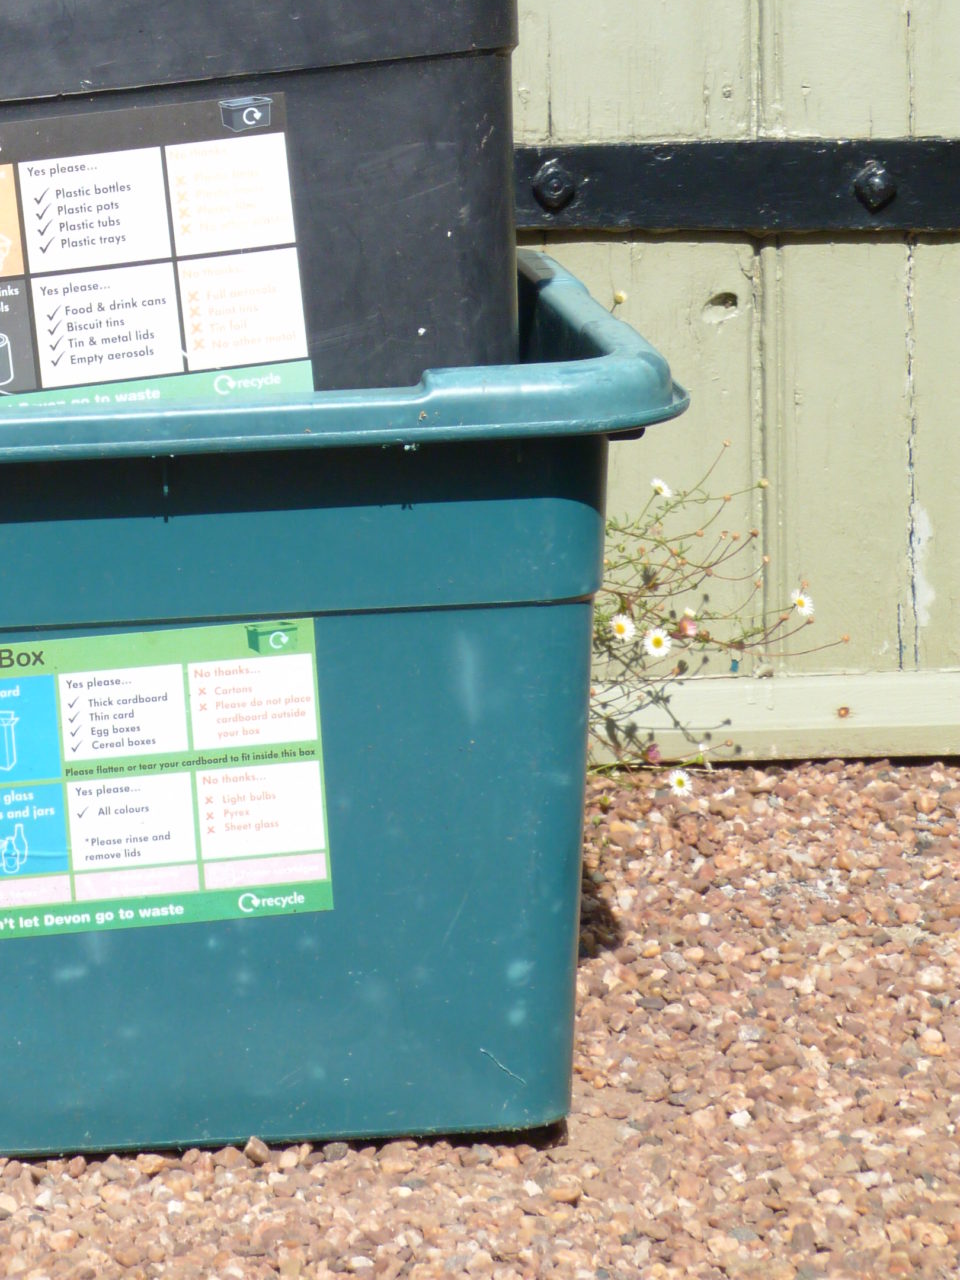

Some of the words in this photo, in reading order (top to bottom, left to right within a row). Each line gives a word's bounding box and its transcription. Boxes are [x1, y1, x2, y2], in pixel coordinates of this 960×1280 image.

[27, 166, 46, 177] Yes
[49, 163, 98, 178] please...
[56, 186, 90, 199] Plastic
[94, 182, 131, 195] bottles
[57, 203, 92, 216] Plastic
[96, 201, 120, 214] pots
[59, 220, 94, 232] Plastic
[98, 216, 120, 228] tubs
[61, 236, 96, 248] Plastic
[100, 234, 126, 245] trays
[40, 286, 59, 296] Yes
[63, 282, 111, 296] please...
[65, 303, 93, 316] Food
[97, 302, 105, 312] &
[110, 297, 138, 311] drink
[141, 296, 167, 307] cans
[67, 319, 102, 332] Biscuit
[106, 317, 125, 327] tins
[68, 337, 84, 349] Tin
[89, 336, 97, 346] &
[101, 331, 132, 345] metal
[136, 329, 155, 340] lids
[70, 352, 103, 365] Empty
[108, 345, 154, 361] aerosols
[238, 372, 281, 389] recycle
[115, 388, 160, 402] waste
[194, 669, 210, 678] No
[66, 680, 83, 689] Yes
[87, 677, 132, 689] please...
[214, 686, 253, 695] Cartons
[88, 697, 113, 707] Thick
[116, 692, 168, 705] cardboard
[215, 700, 247, 710] Please
[250, 698, 263, 707] do
[266, 697, 281, 705] not
[284, 695, 311, 705] place
[89, 712, 109, 721] Thin
[113, 709, 134, 719] card
[217, 711, 268, 724] cardboard
[271, 708, 306, 719] outside
[91, 727, 109, 737] Egg
[112, 725, 141, 734] boxes
[218, 730, 239, 740] your
[242, 727, 260, 736] box
[92, 738, 125, 749] Cereal
[128, 737, 156, 746] boxes
[65, 768, 94, 777] Please
[96, 761, 125, 774] flatten
[127, 763, 137, 771] or
[139, 761, 157, 770] tear
[159, 759, 179, 771] your
[181, 754, 228, 767] cardboard
[230, 755, 239, 763] to
[241, 752, 251, 761] fit
[253, 750, 279, 760] inside
[281, 749, 297, 758] this
[299, 747, 316, 756] box
[202, 776, 218, 785] No
[3, 789, 34, 805] glass
[75, 787, 93, 796] Yes
[96, 785, 141, 797] please...
[222, 794, 246, 805] Light
[250, 791, 276, 801] bulbs
[7, 806, 29, 819] and
[33, 805, 55, 820] jars
[98, 806, 111, 816] All
[114, 804, 149, 815] colours
[224, 809, 250, 819] Pyrex
[225, 822, 251, 832] Sheet
[255, 820, 279, 832] glass
[126, 835, 149, 843] rinse
[152, 831, 171, 840] and
[85, 852, 121, 861] remove
[124, 848, 141, 857] lids
[261, 892, 305, 908] recycle
[19, 916, 39, 928] let
[44, 912, 91, 927] Devon
[96, 911, 114, 924] go
[119, 908, 134, 919] to
[139, 903, 184, 918] waste
